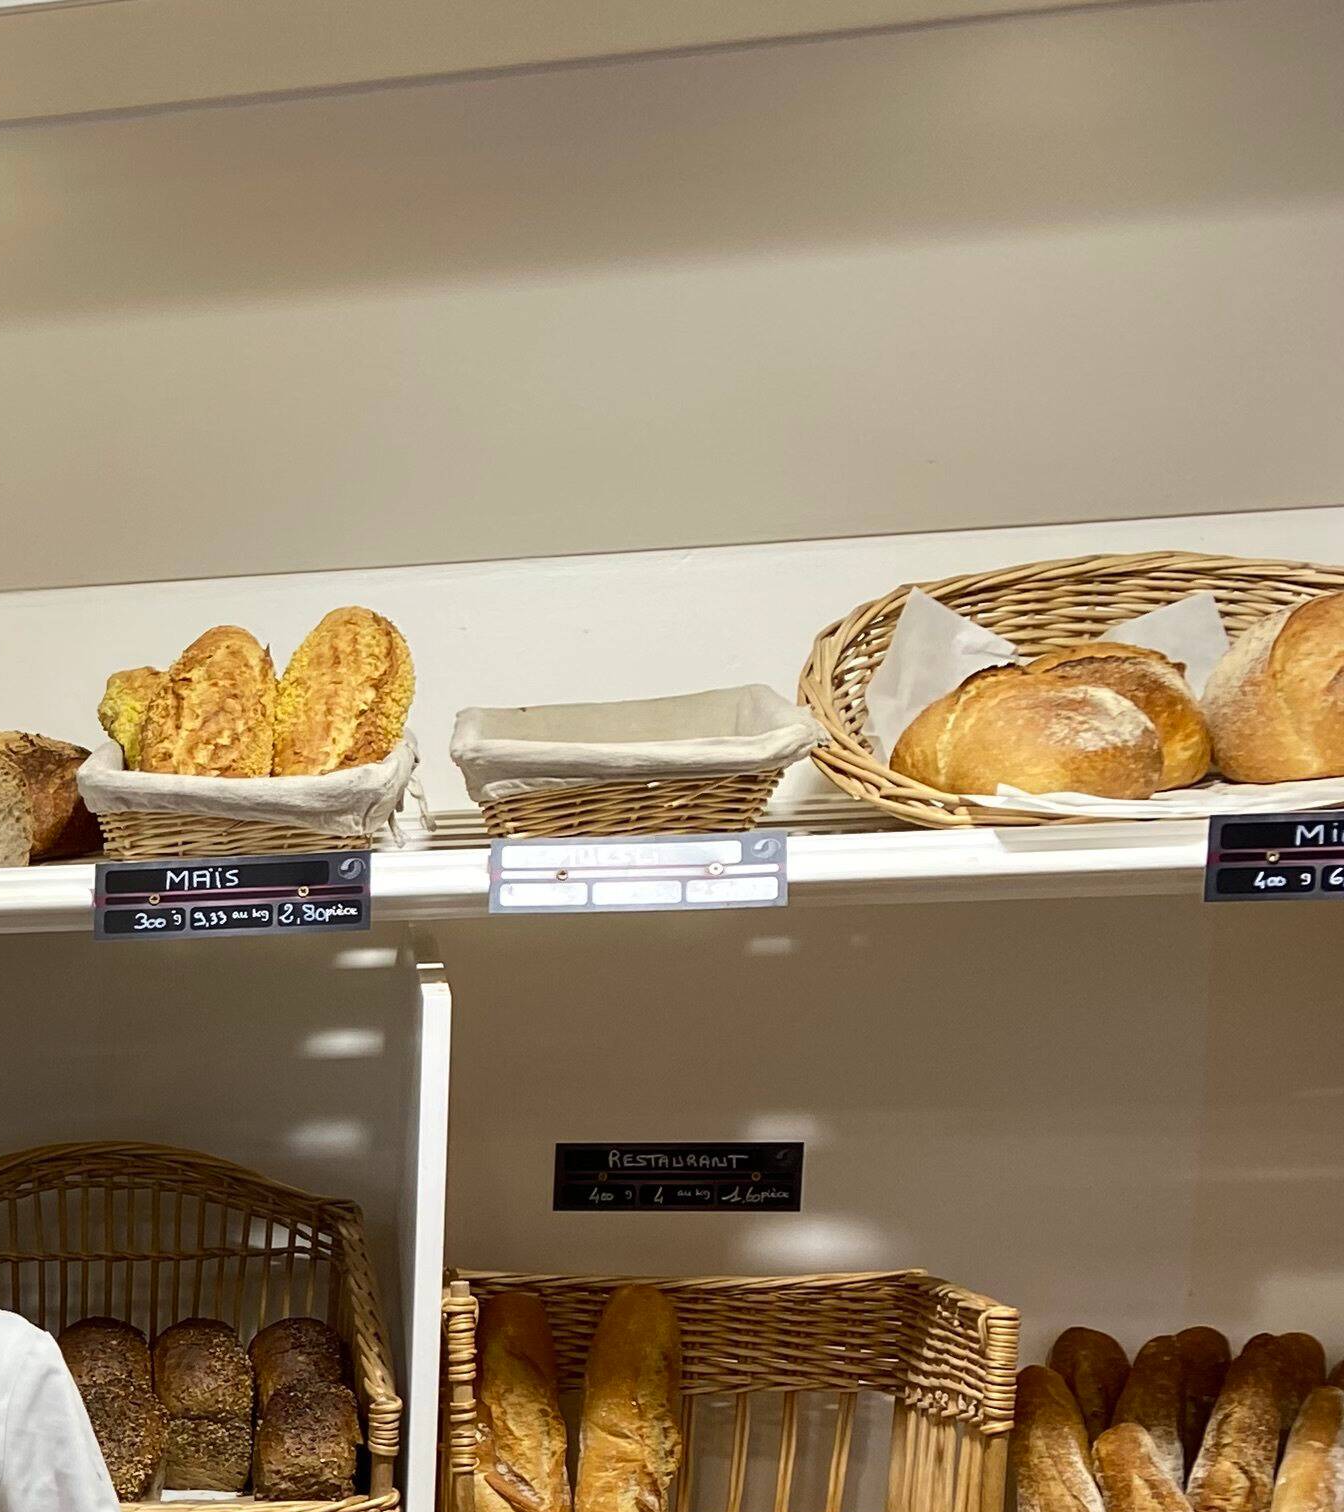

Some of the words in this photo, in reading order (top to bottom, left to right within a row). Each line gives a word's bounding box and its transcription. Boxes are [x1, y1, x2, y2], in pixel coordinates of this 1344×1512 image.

[1253, 871, 1288, 890] 400
[1300, 872, 1312, 886] g
[133, 913, 166, 930] 300
[193, 911, 228, 928] 9,33
[232, 910, 249, 920] au
[252, 908, 269, 923] kg
[279, 904, 327, 925] 2,80
[608, 1150, 749, 1169] RESTAURANT
[589, 1187, 614, 1203] 400
[654, 1187, 664, 1203] 4
[677, 1190, 692, 1198] au
[695, 1189, 711, 1200] kg
